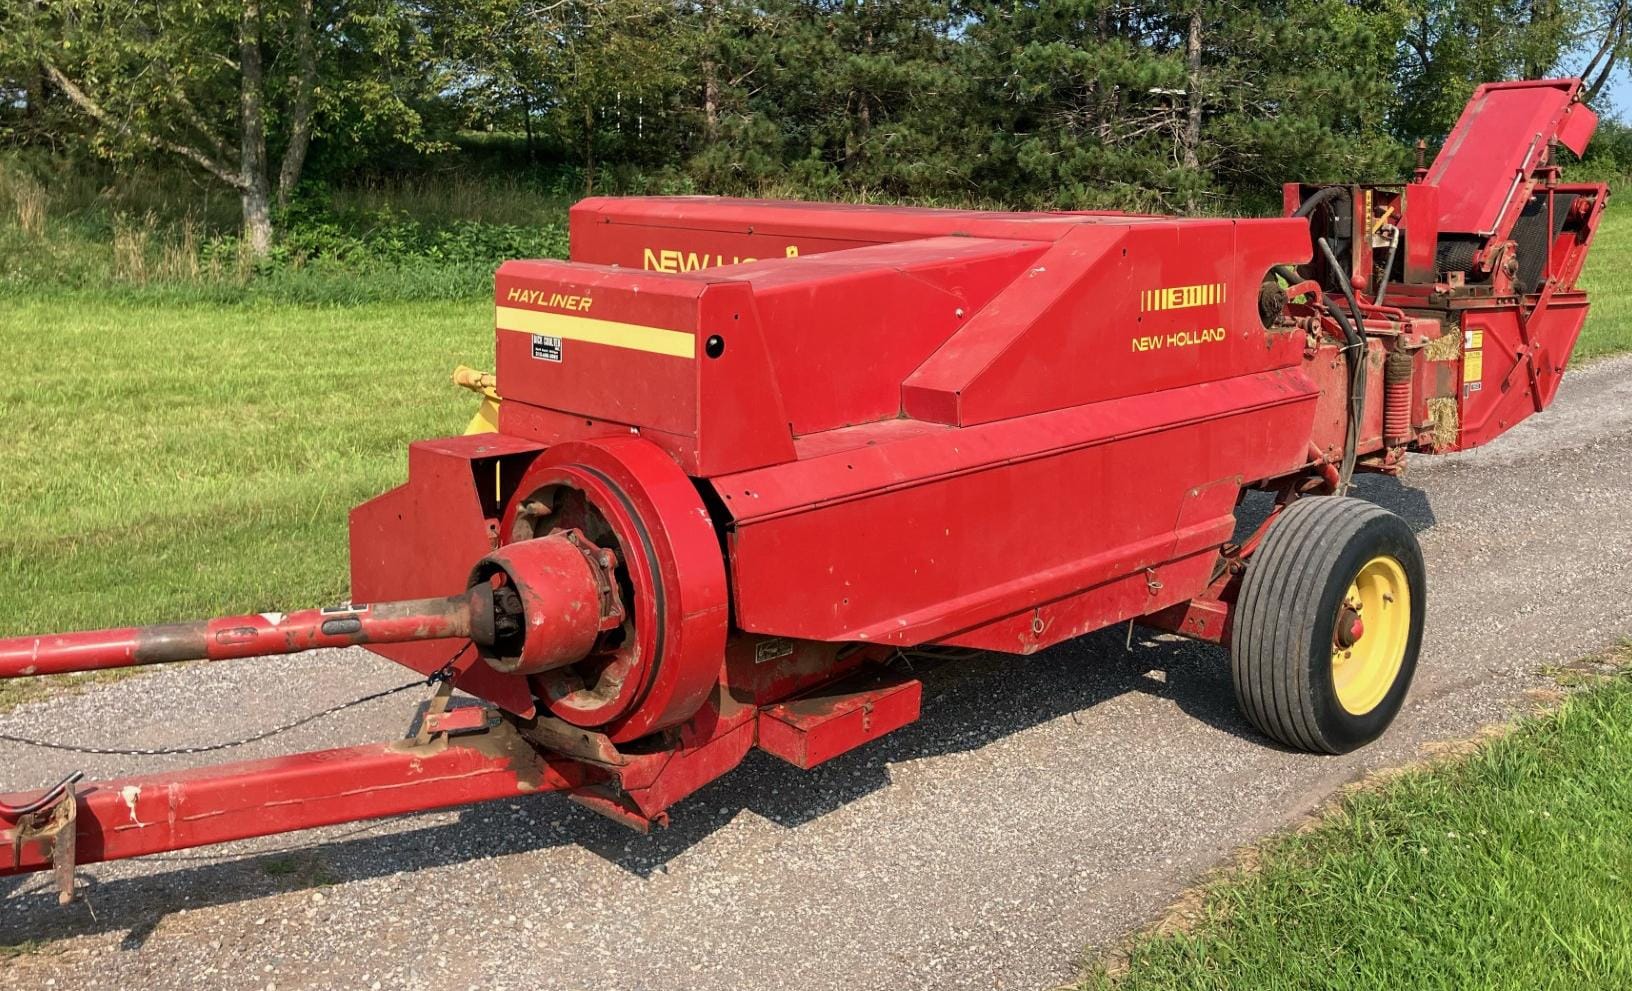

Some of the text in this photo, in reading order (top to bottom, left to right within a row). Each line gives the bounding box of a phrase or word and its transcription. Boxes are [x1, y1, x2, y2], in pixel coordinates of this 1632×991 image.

[644, 248, 709, 274] NEW
[507, 287, 593, 312] HAYLINER
[1172, 288, 1198, 306] 311
[1132, 327, 1226, 352] NEW HOLLAND
